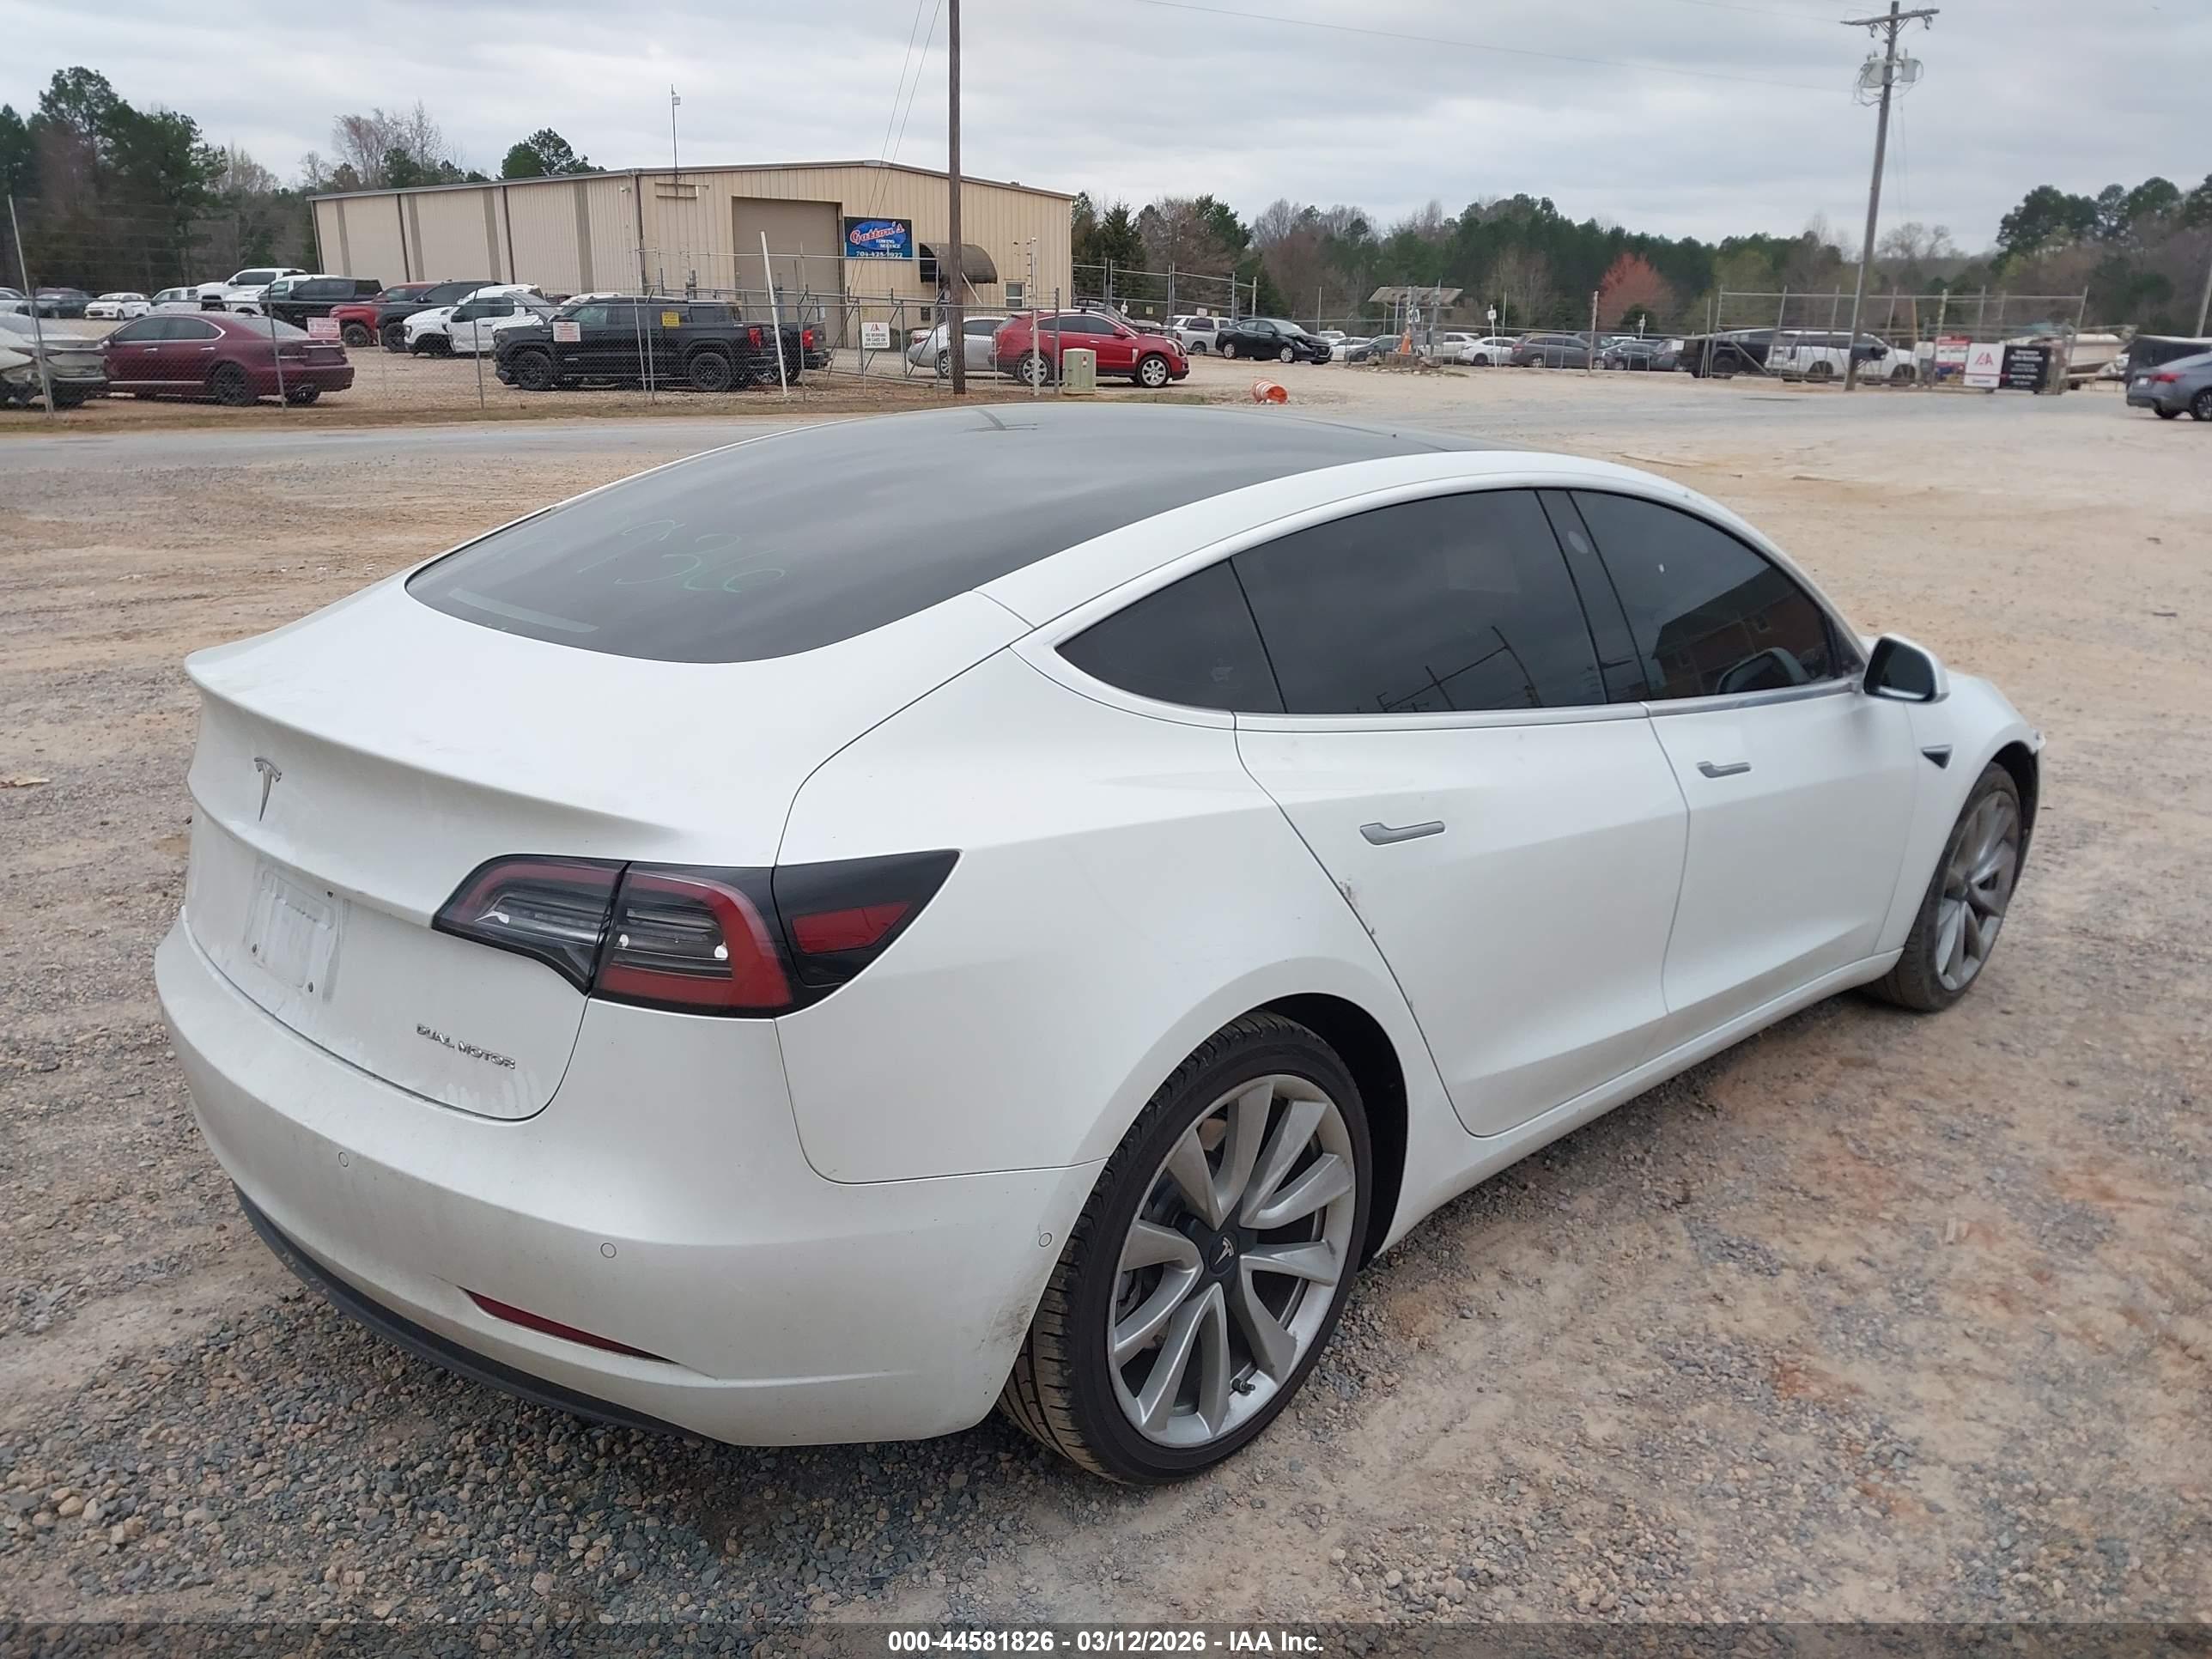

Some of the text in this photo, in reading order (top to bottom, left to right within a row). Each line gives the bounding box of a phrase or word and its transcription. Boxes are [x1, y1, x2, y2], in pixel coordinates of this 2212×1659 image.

[850, 221, 905, 245] Gatton's
[416, 1024, 516, 1070] DUAL MOTOR
